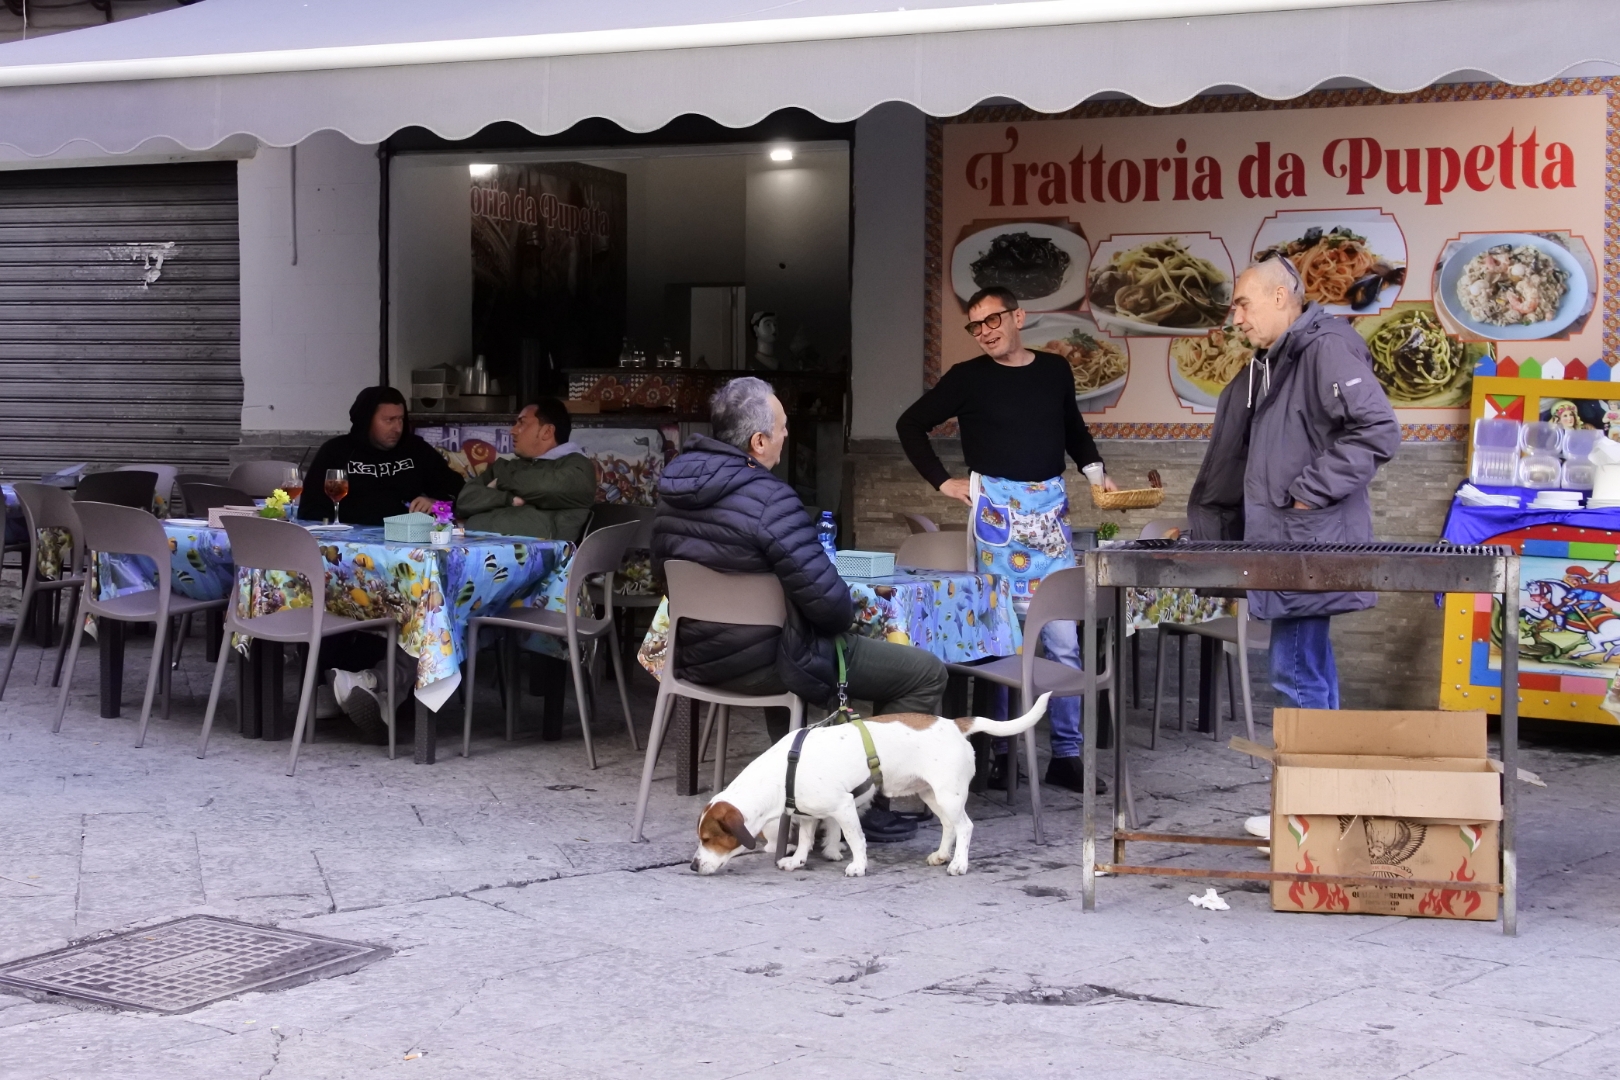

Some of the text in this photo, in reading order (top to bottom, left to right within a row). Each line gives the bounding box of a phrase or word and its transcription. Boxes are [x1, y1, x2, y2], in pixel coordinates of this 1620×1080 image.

[965, 126, 1576, 207] Trattoria da Pupetta
[470, 179, 610, 238] oria da Pupetta
[347, 458, 415, 478] Kappa
